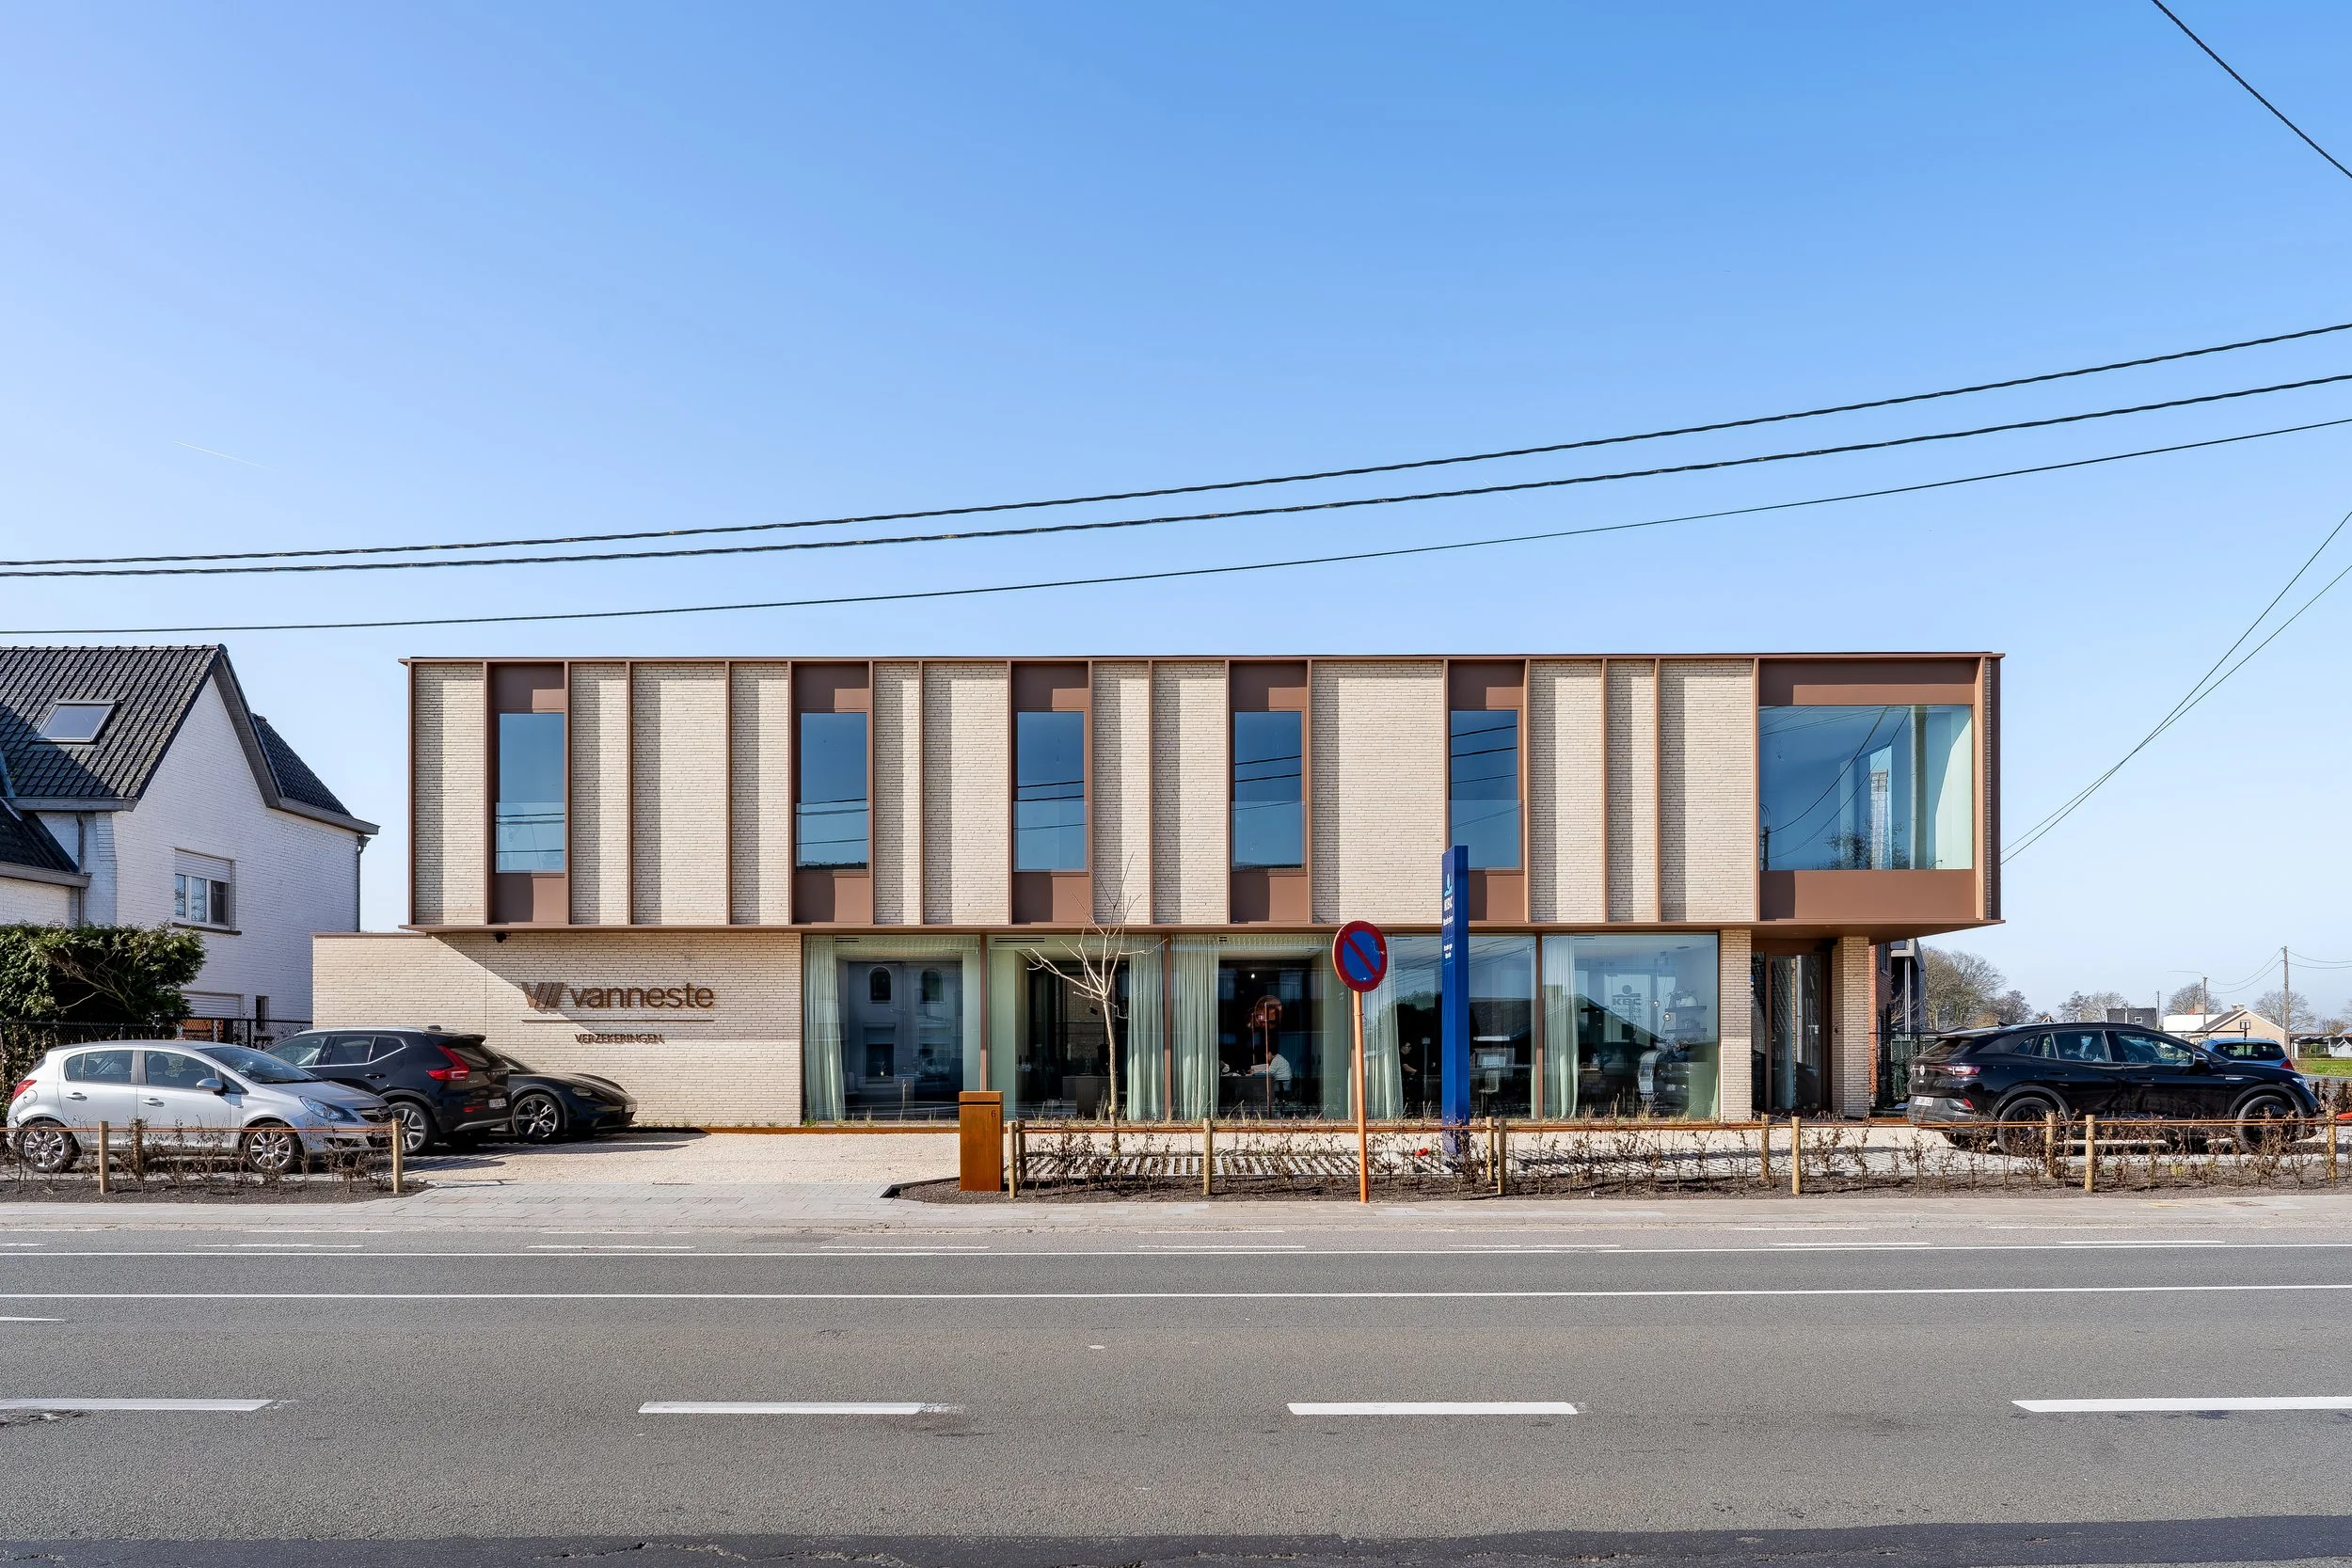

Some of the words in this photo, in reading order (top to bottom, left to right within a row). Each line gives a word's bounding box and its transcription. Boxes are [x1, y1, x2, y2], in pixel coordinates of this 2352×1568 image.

[569, 982, 715, 1009] vanneste
[574, 1033, 664, 1045] VERZEKERINGEN
[991, 1109, 996, 1118] 6
